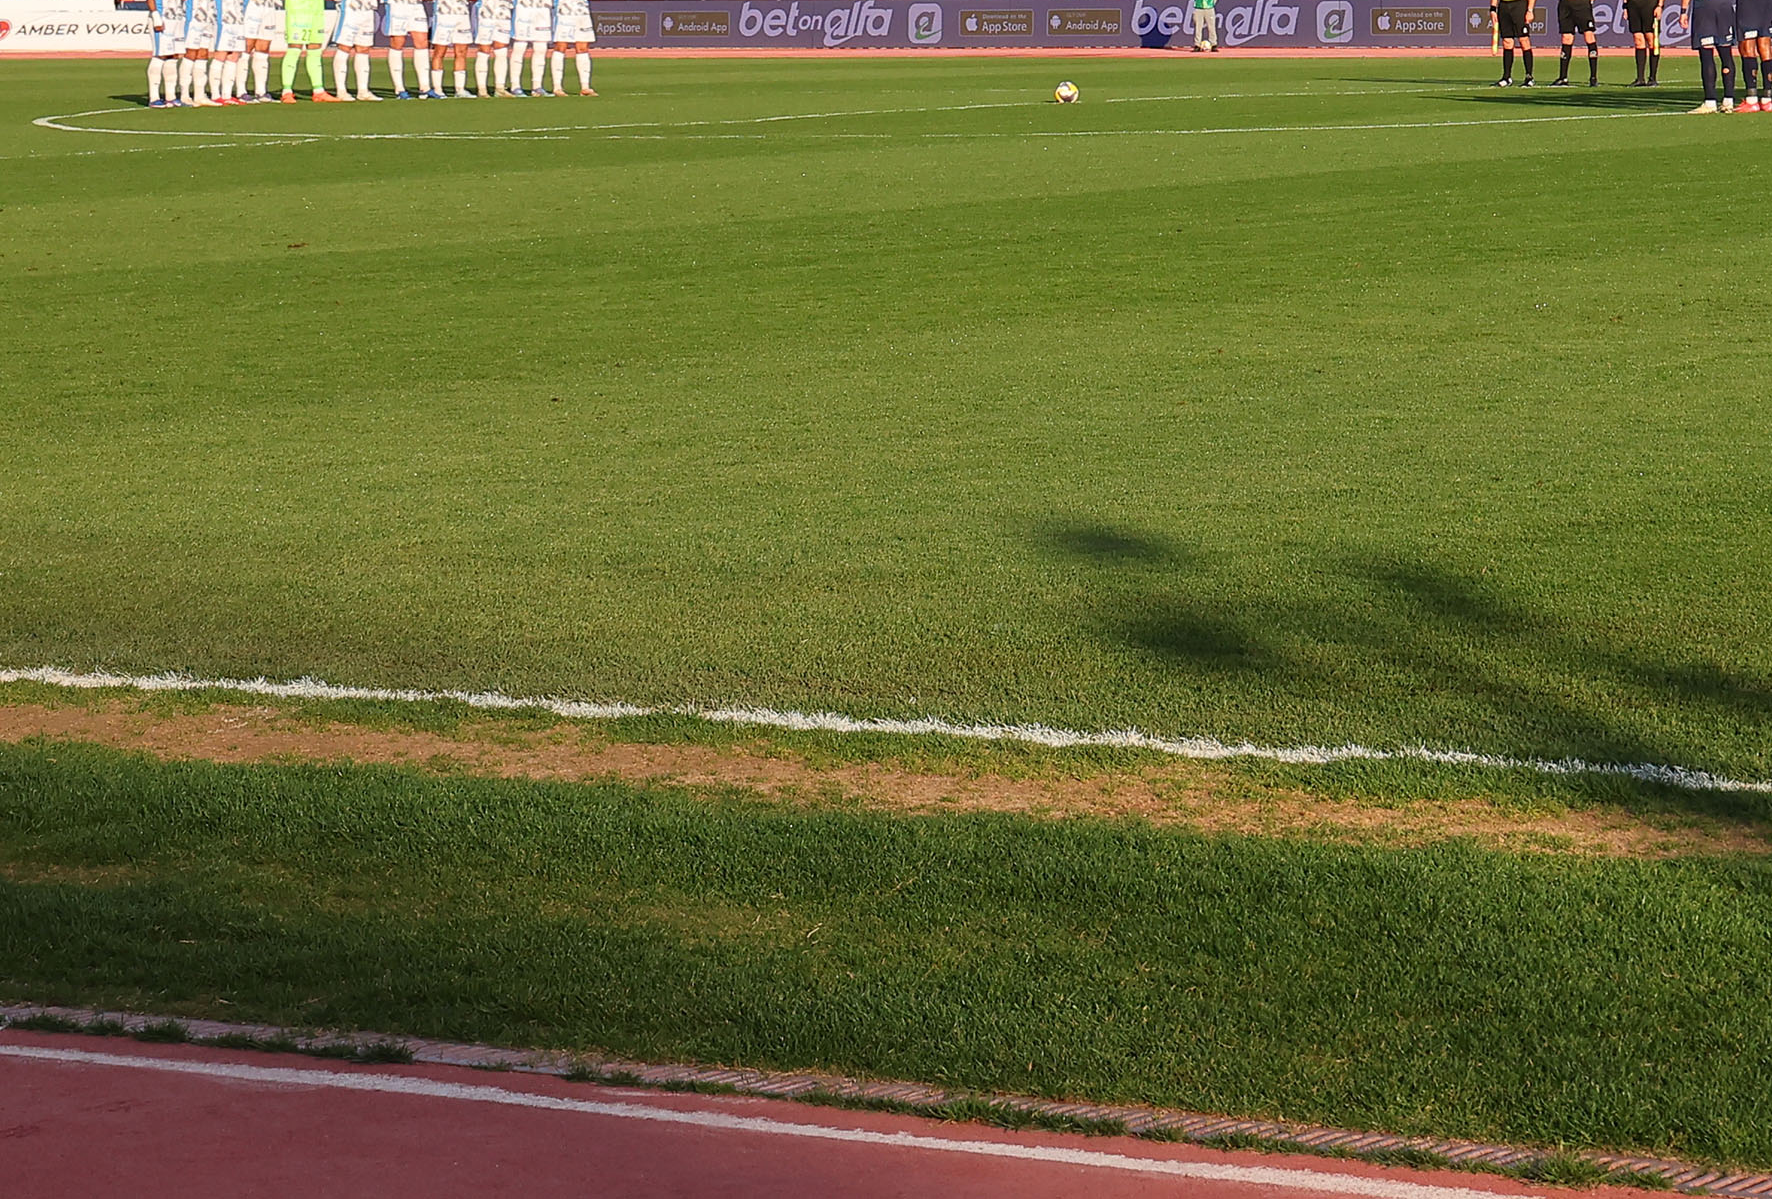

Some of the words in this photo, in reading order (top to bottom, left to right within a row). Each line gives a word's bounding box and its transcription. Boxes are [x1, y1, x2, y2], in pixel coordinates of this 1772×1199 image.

[16, 24, 78, 36] AMBER
[597, 23, 615, 36] App
[617, 23, 640, 33] Store
[678, 21, 709, 32] Android
[710, 22, 727, 34] App
[739, 1, 799, 37] bet
[799, 14, 821, 31] on
[823, 0, 893, 47] alfa
[982, 20, 1001, 34] App
[1002, 20, 1027, 31] Store
[1065, 20, 1097, 31] Android
[1099, 21, 1118, 33] App
[1394, 19, 1415, 33] App
[1417, 19, 1444, 30] Store
